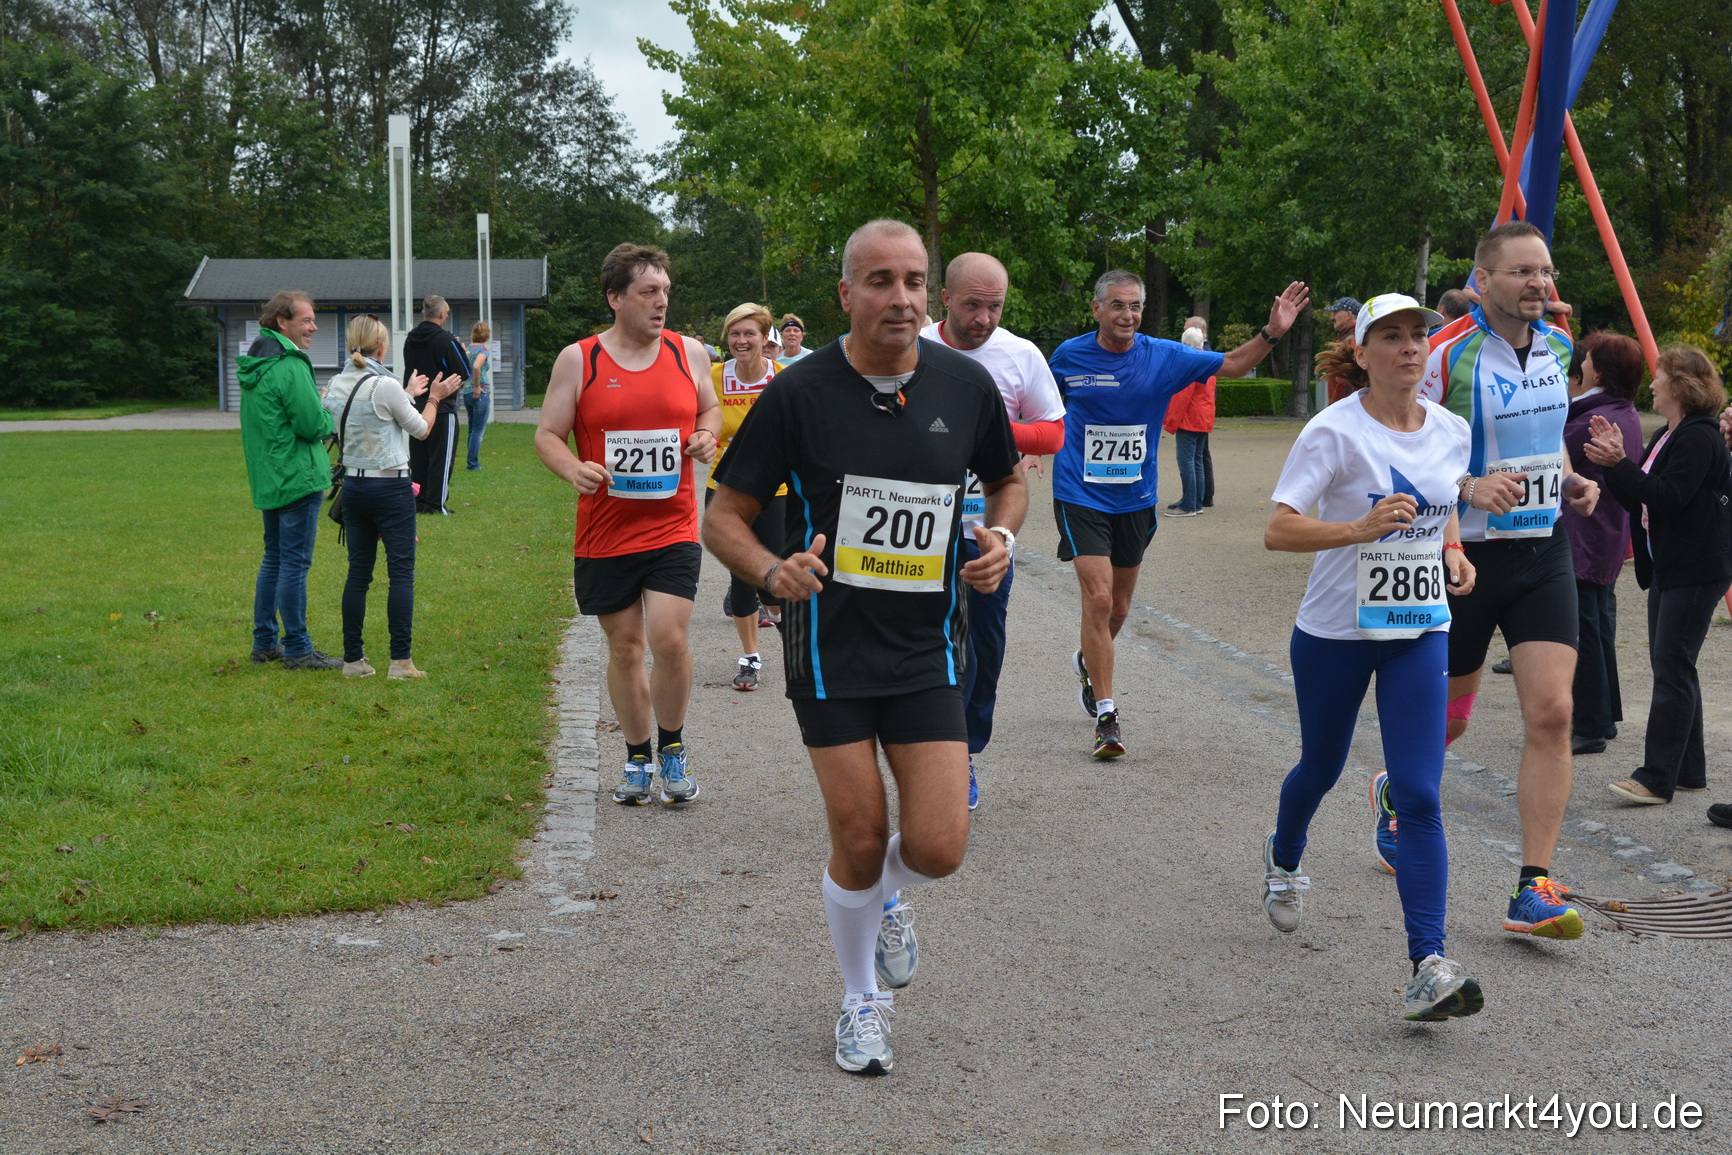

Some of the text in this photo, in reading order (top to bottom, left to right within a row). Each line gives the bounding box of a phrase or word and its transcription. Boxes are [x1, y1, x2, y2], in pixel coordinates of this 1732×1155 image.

[723, 398, 747, 407] MAX
[1495, 402, 1567, 420] www.tr-plast.de
[607, 436, 669, 445] PARTL Neumarkt
[1086, 430, 1108, 438] PARTL
[1091, 439, 1143, 461] 2745
[613, 446, 676, 473] 2216
[1106, 466, 1128, 475] Ernst
[1520, 462, 1555, 473] Neumarkt
[626, 479, 663, 490] Markus
[1516, 473, 1560, 507] 014
[845, 485, 941, 506] PARTL Neumarkt
[963, 502, 979, 512] rio
[862, 505, 936, 550] 200
[1512, 514, 1549, 528] Martin
[1360, 552, 1437, 561] PARTL Neumarkt
[860, 555, 925, 577] Matthias
[1368, 565, 1441, 602] 2868
[1386, 611, 1432, 625] Andrea
